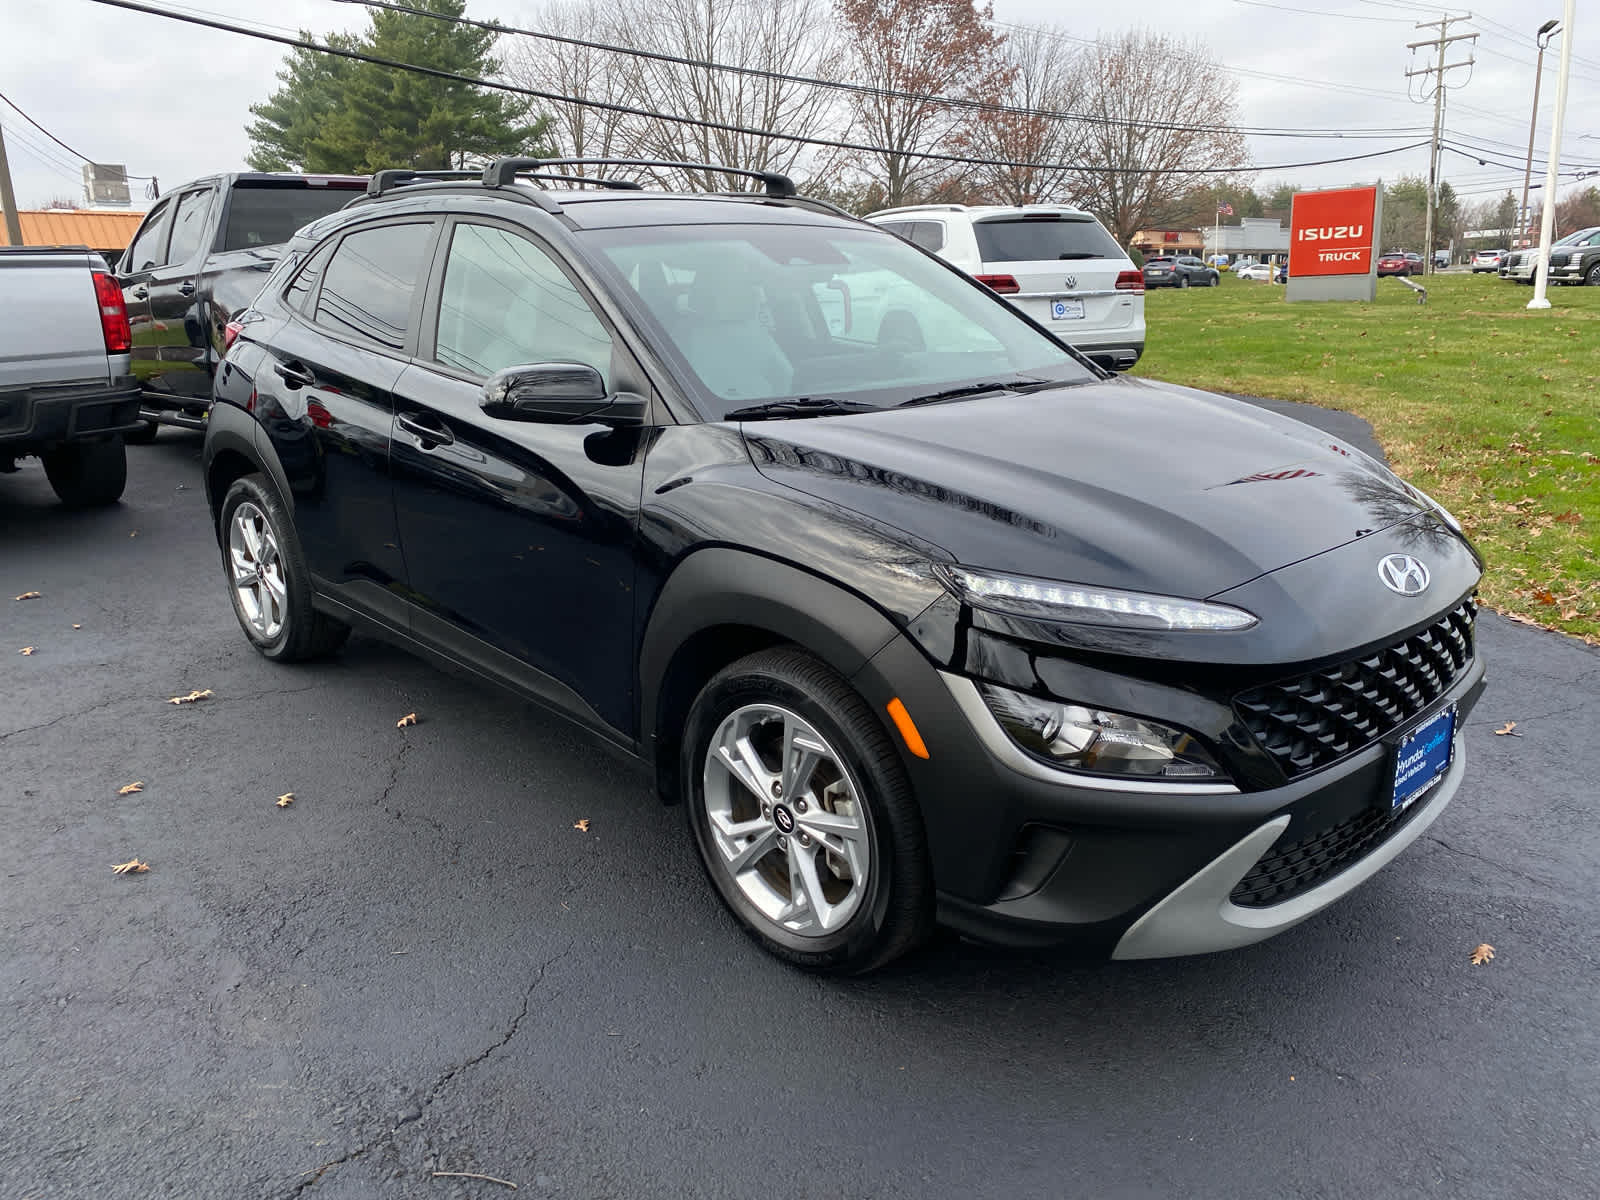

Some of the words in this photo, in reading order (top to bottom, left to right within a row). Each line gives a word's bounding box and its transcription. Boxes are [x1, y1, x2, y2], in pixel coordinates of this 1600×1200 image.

[1298, 224, 1364, 242] ISUZU
[1318, 251, 1361, 262] TRUCK
[1397, 745, 1424, 774] Hyundai
